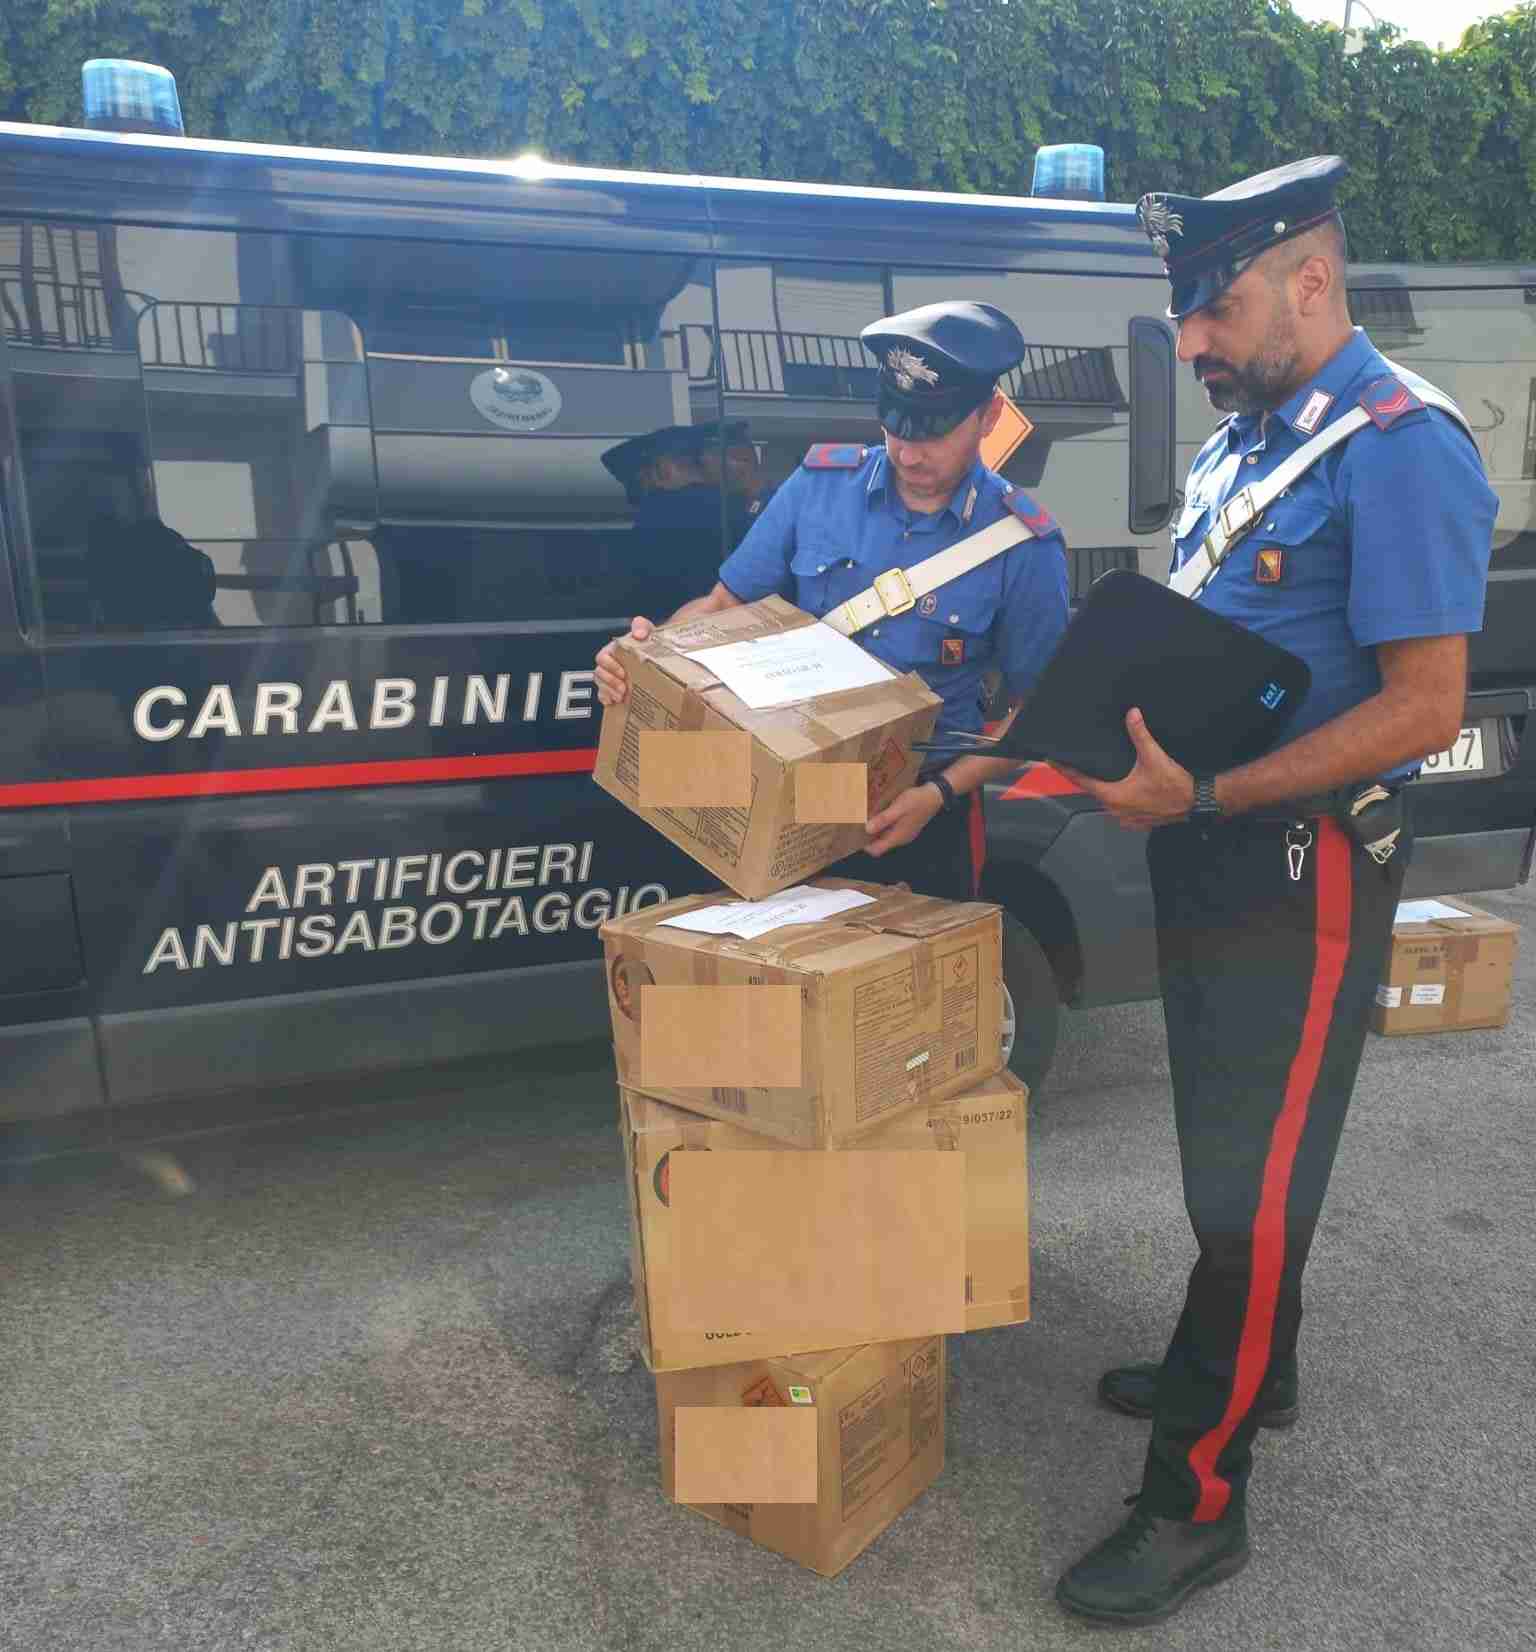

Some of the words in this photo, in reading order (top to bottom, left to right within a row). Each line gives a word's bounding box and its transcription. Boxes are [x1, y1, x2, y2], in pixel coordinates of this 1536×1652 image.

[133, 670, 595, 741] CARABINIE
[245, 842, 595, 912] ARTIFICIERI
[143, 882, 669, 974] ANTISABOTAGGIO
